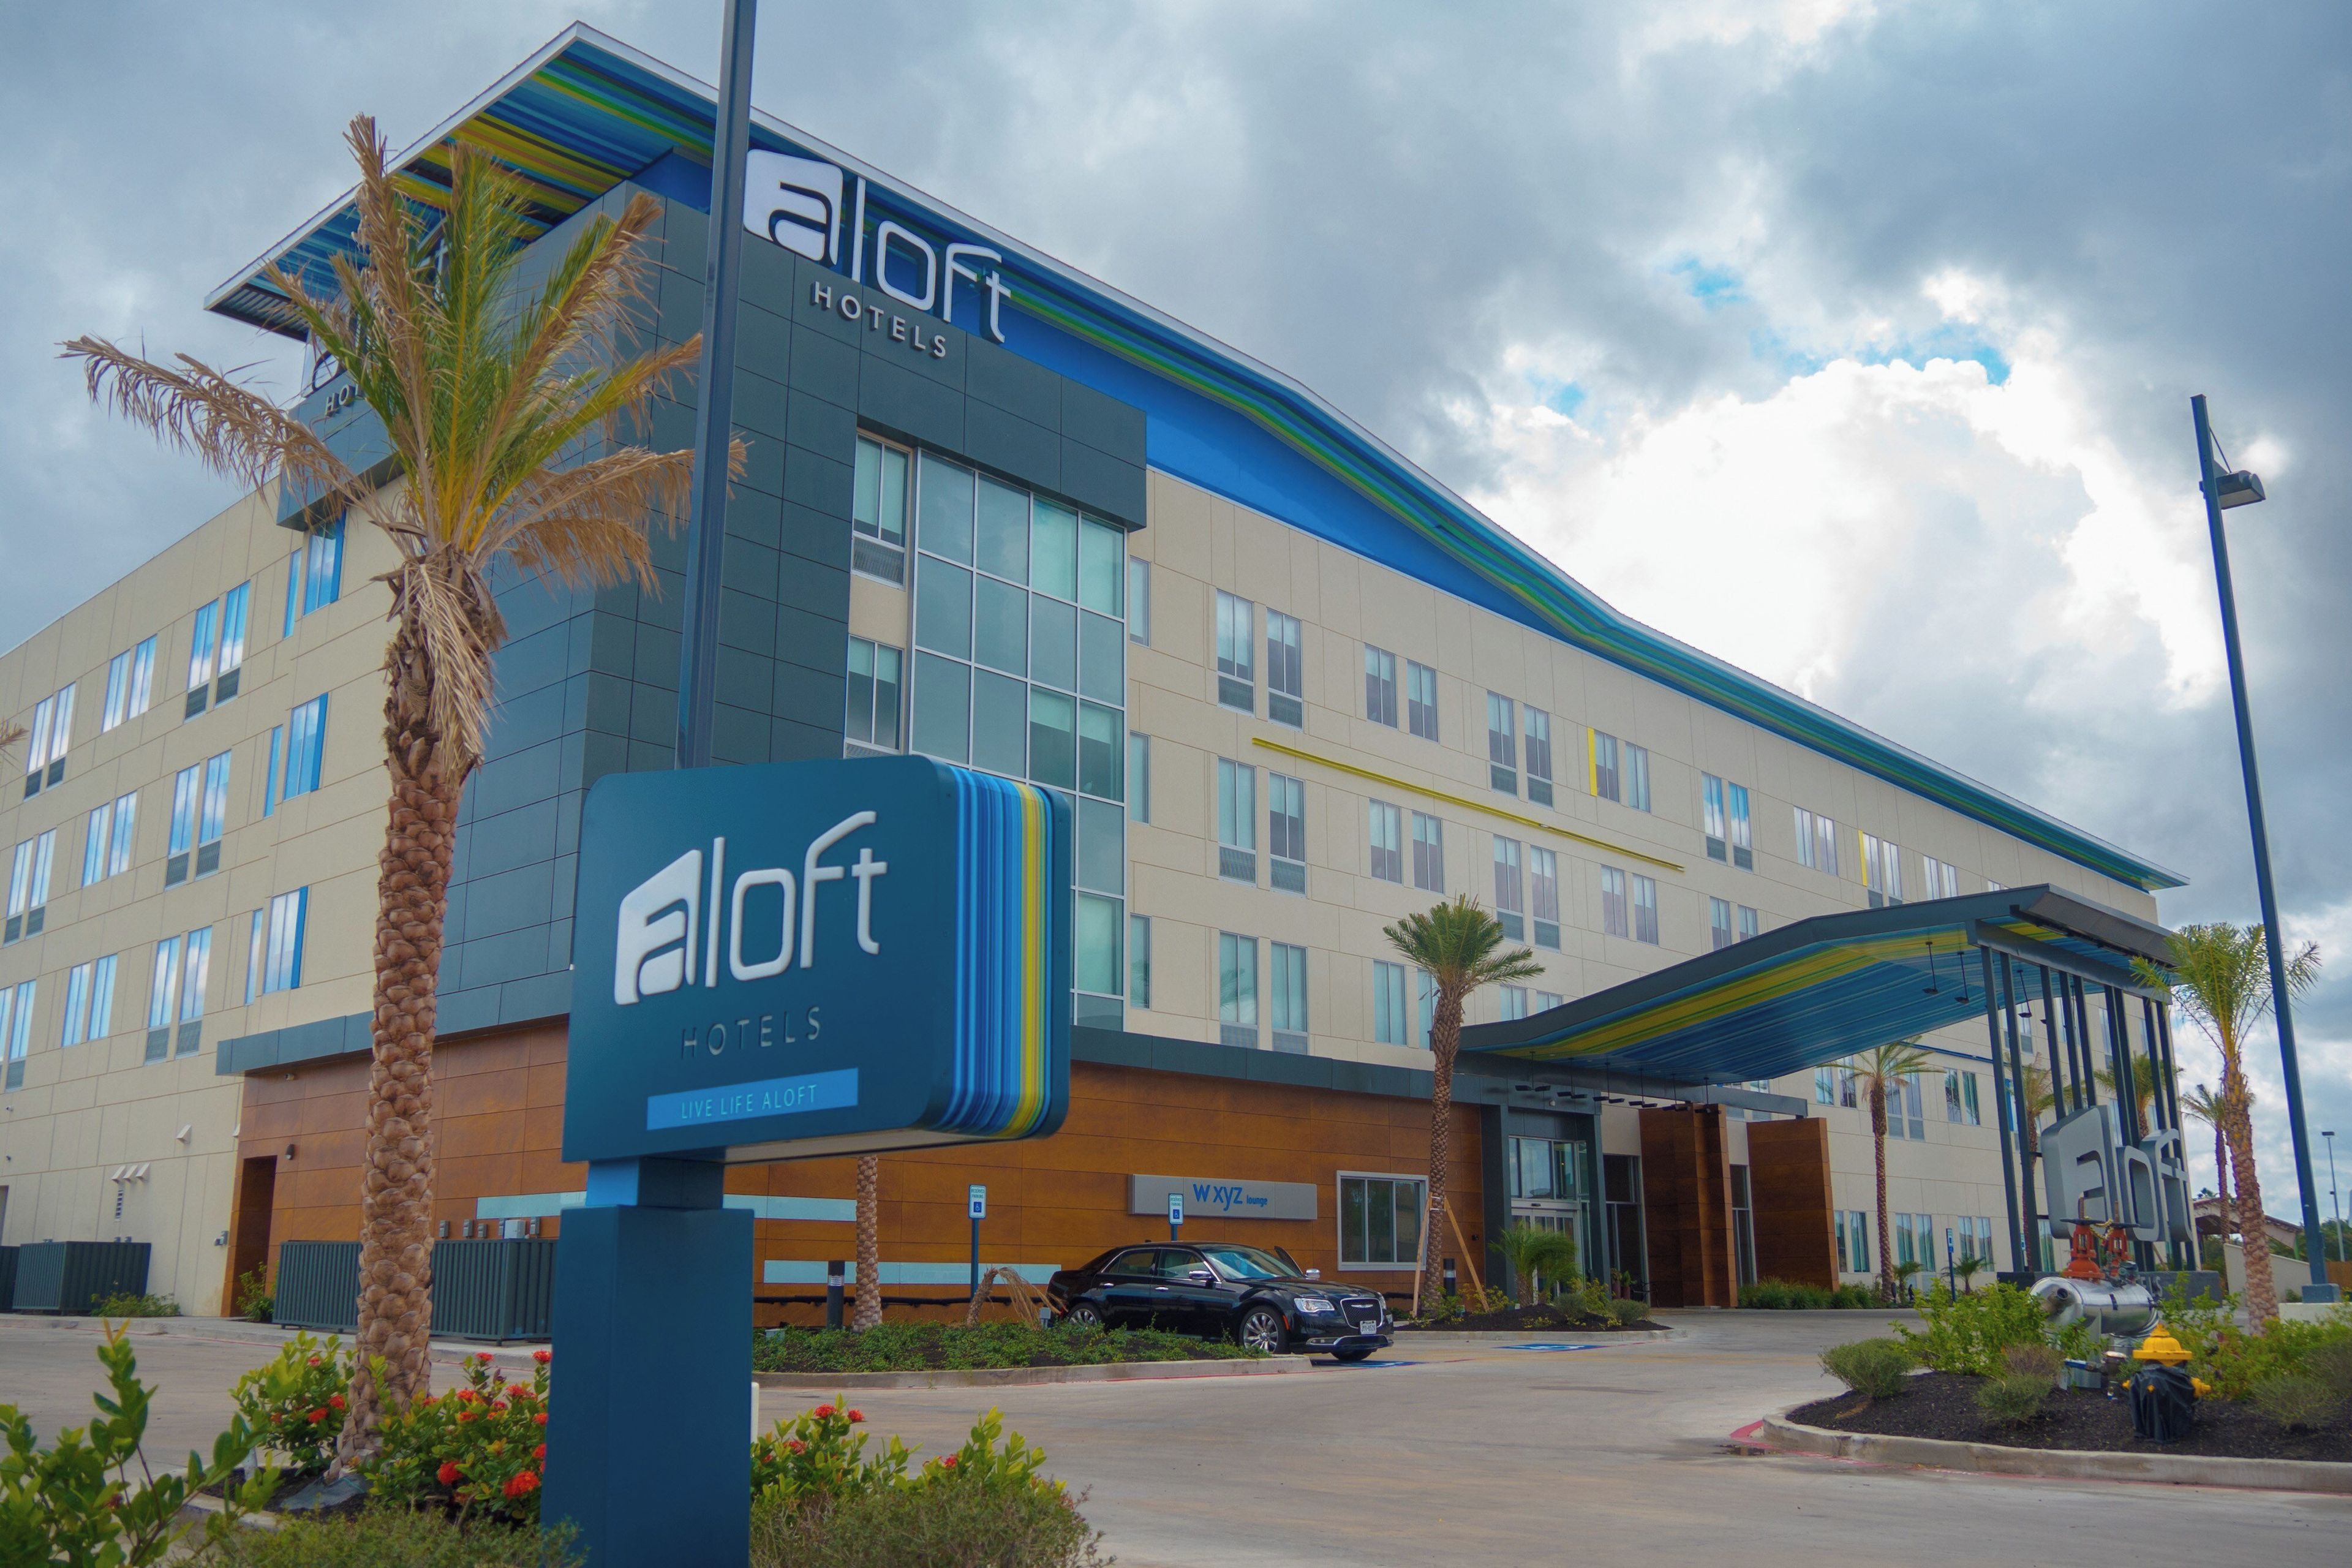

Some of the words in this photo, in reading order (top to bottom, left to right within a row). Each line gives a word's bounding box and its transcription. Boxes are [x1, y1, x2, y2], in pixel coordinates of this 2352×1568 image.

[742, 148, 1011, 344] aloft
[812, 281, 946, 358] HOTELS
[614, 810, 888, 1005] aloft
[681, 1006, 821, 1060] HOTELS
[681, 1099, 713, 1120] LIVE
[720, 1093, 754, 1115] LIFE
[762, 1085, 817, 1110] ALOFT
[1246, 1194, 1268, 1208] lounge
